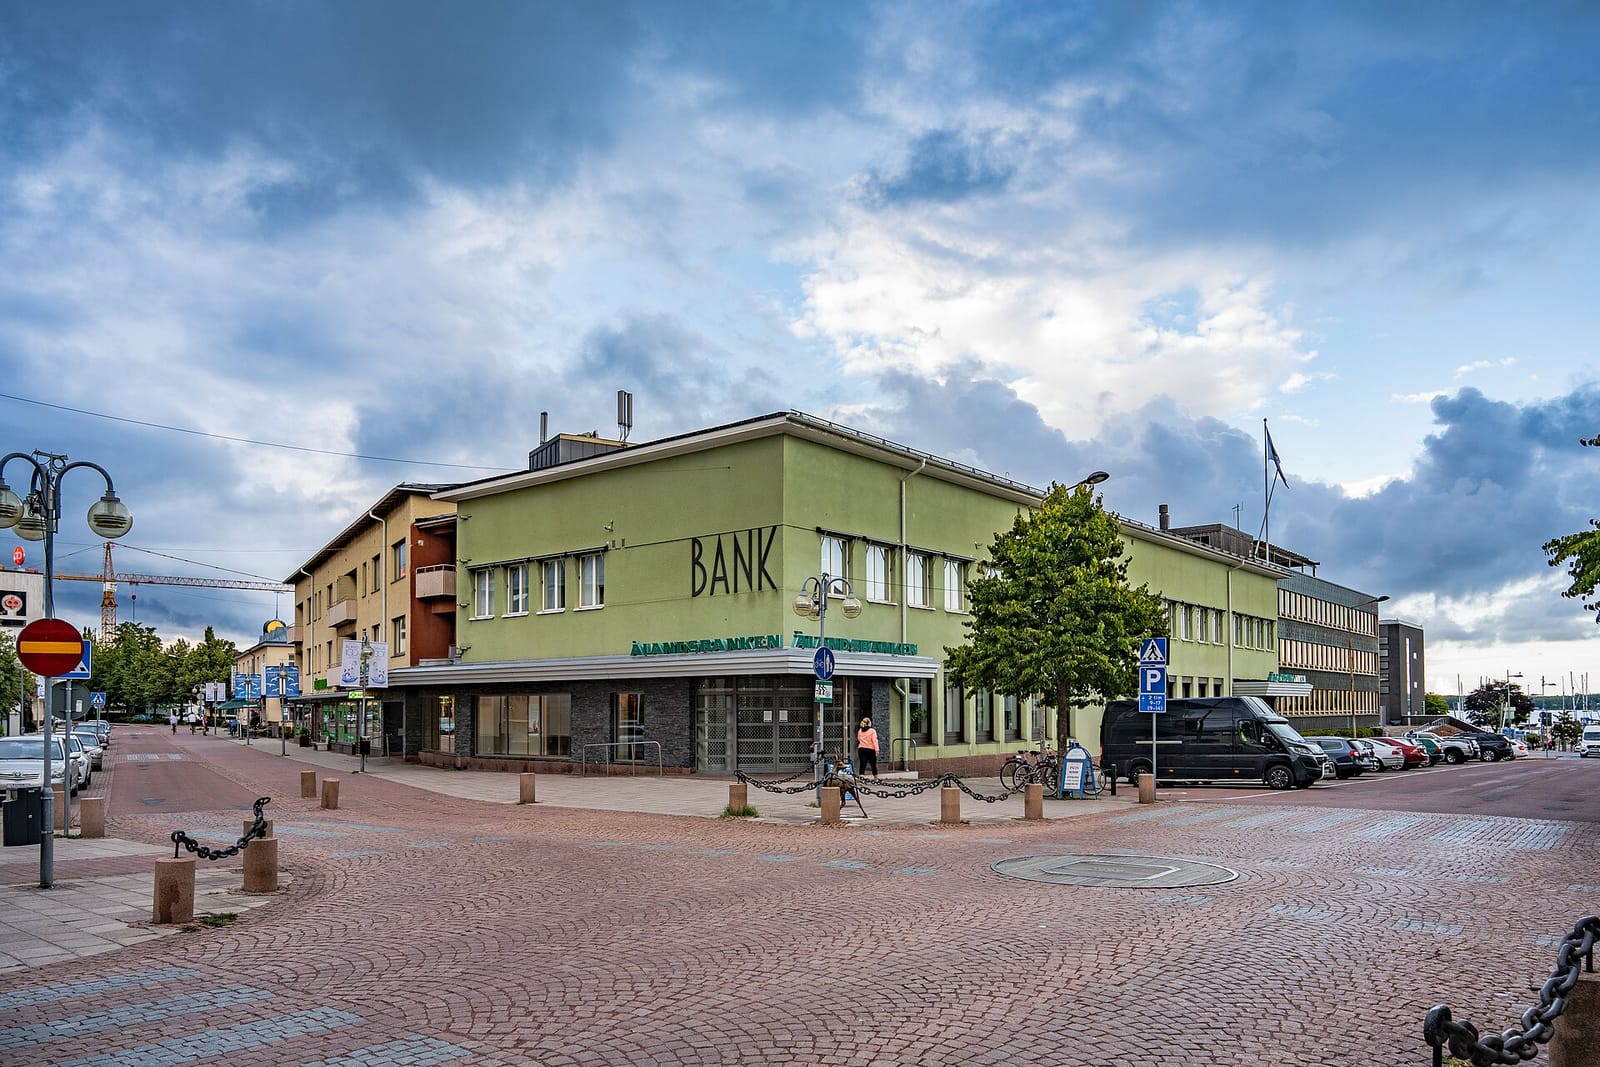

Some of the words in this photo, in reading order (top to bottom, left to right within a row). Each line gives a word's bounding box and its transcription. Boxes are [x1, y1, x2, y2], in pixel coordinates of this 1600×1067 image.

[691, 526, 778, 597] BANK
[631, 635, 784, 656] ÅLANDSBANKEN
[1146, 669, 1161, 691] P
